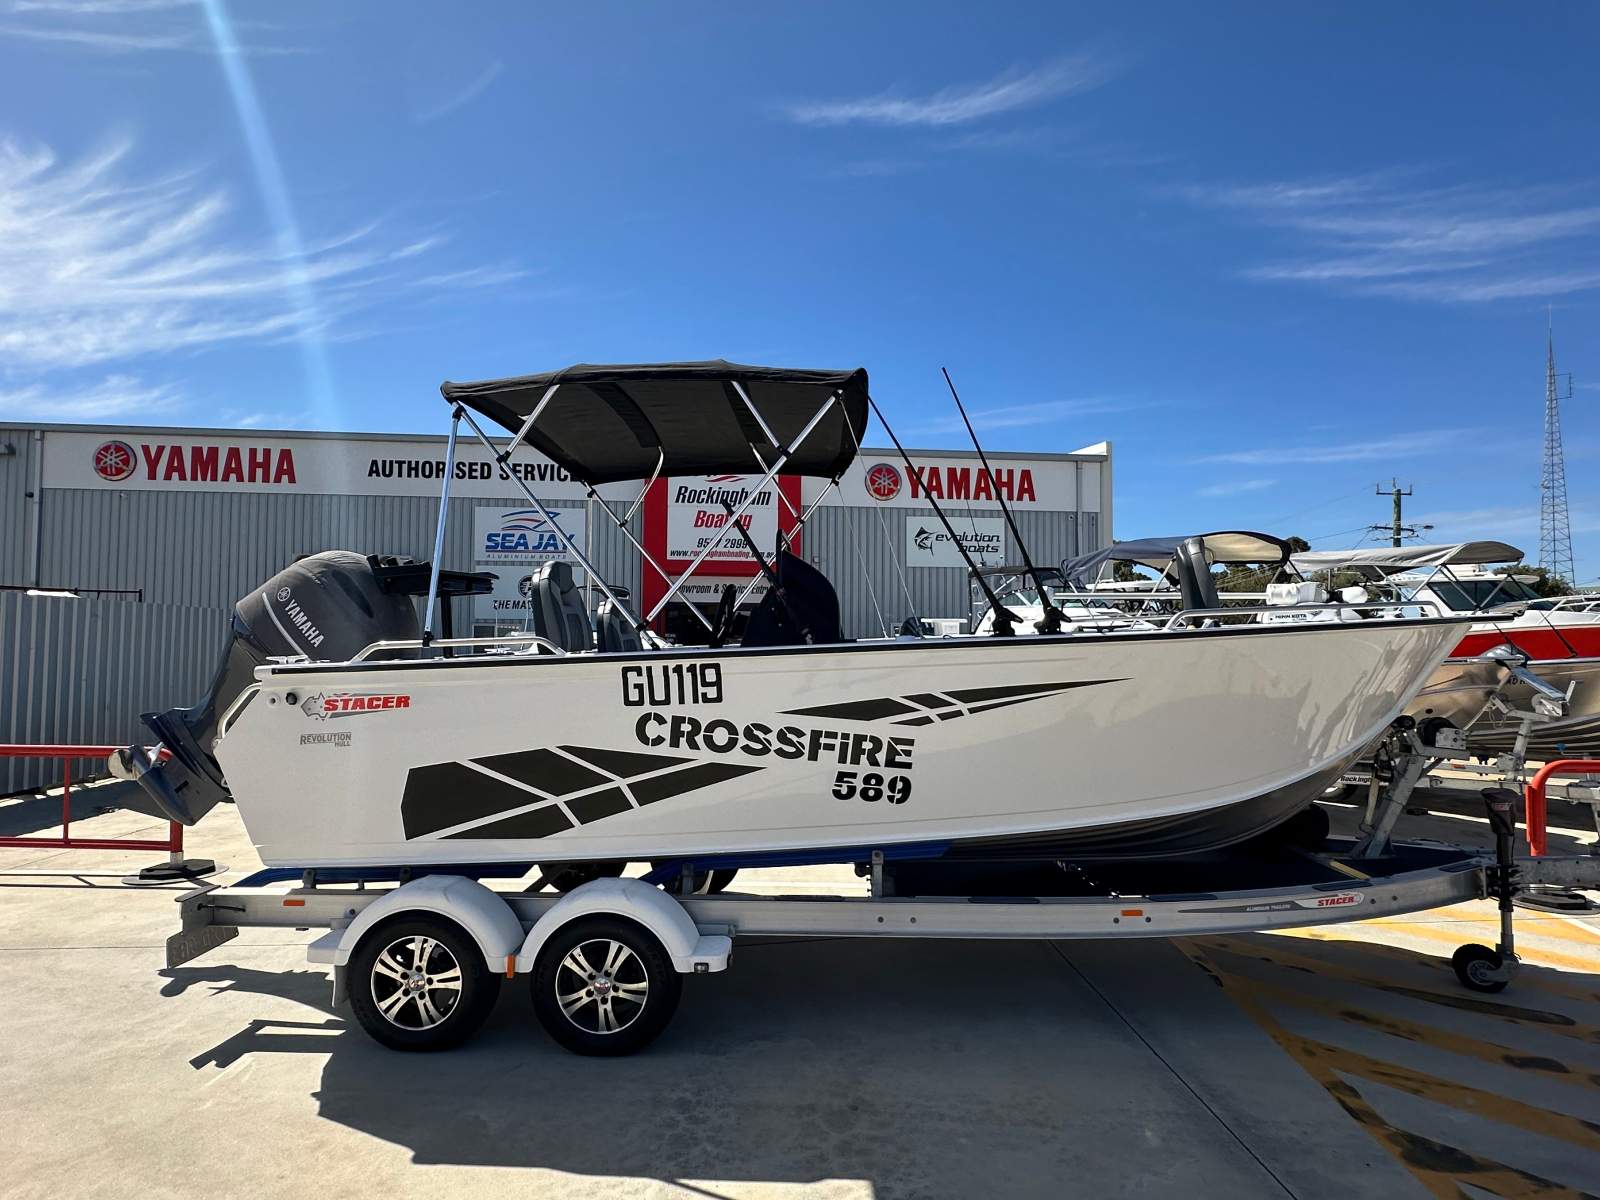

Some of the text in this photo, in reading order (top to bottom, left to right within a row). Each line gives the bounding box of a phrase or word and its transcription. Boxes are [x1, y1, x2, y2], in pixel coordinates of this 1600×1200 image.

[141, 445, 296, 484] YAMAHA
[499, 462, 581, 482] SERVIC
[904, 465, 1036, 502] YAMAHA
[485, 532, 530, 550] SEA
[713, 583, 719, 594] &
[493, 600, 511, 610] THE
[284, 599, 325, 648] YAMAHA
[620, 662, 724, 707] GU119
[323, 695, 411, 712] STACER
[300, 733, 352, 745] REVOLUTION
[831, 771, 912, 805] 589
[1317, 896, 1355, 907] STACER
